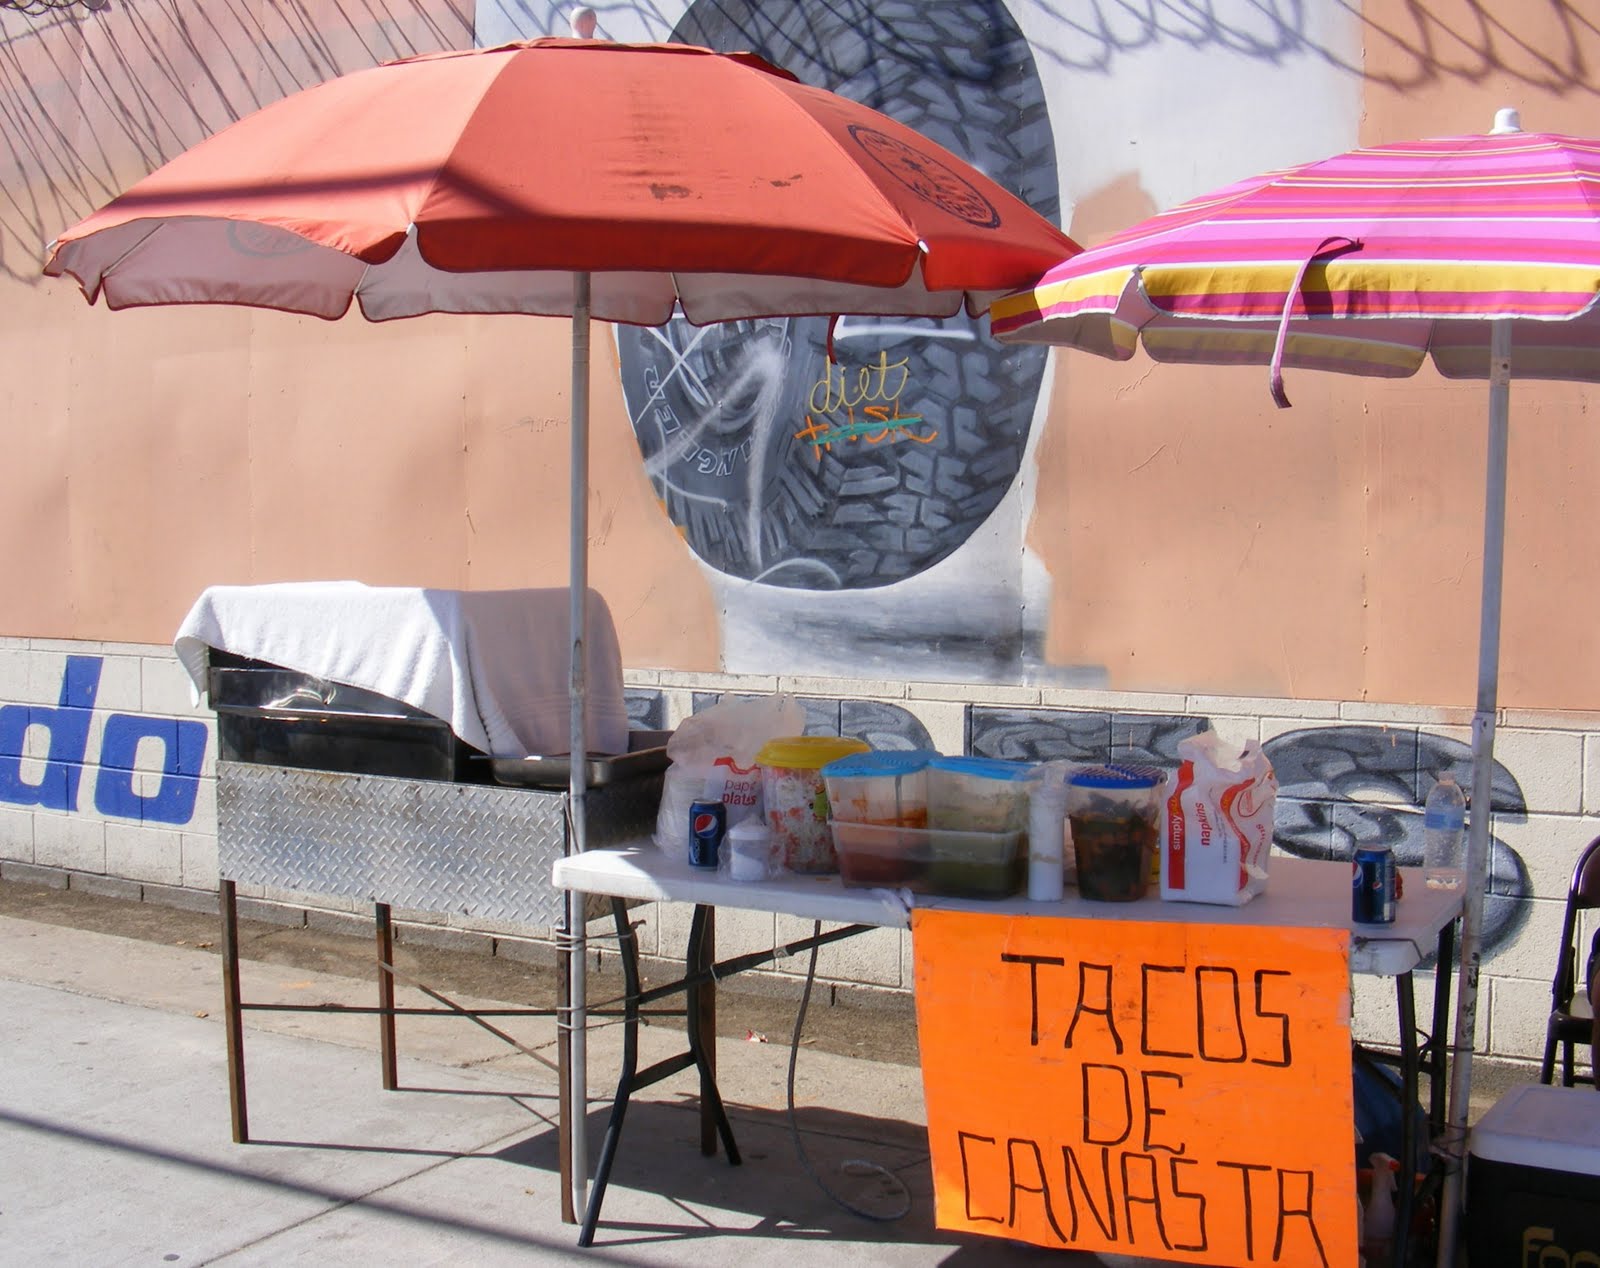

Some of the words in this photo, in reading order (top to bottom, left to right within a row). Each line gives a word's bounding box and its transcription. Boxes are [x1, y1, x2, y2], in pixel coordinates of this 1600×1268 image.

[810, 350, 910, 414] diet
[1171, 814, 1183, 851] simply
[1195, 802, 1213, 847] napkins
[1001, 952, 1292, 1068] TACOS
[1081, 1062, 1186, 1155] DE
[957, 1130, 1329, 1268] CANASTA
